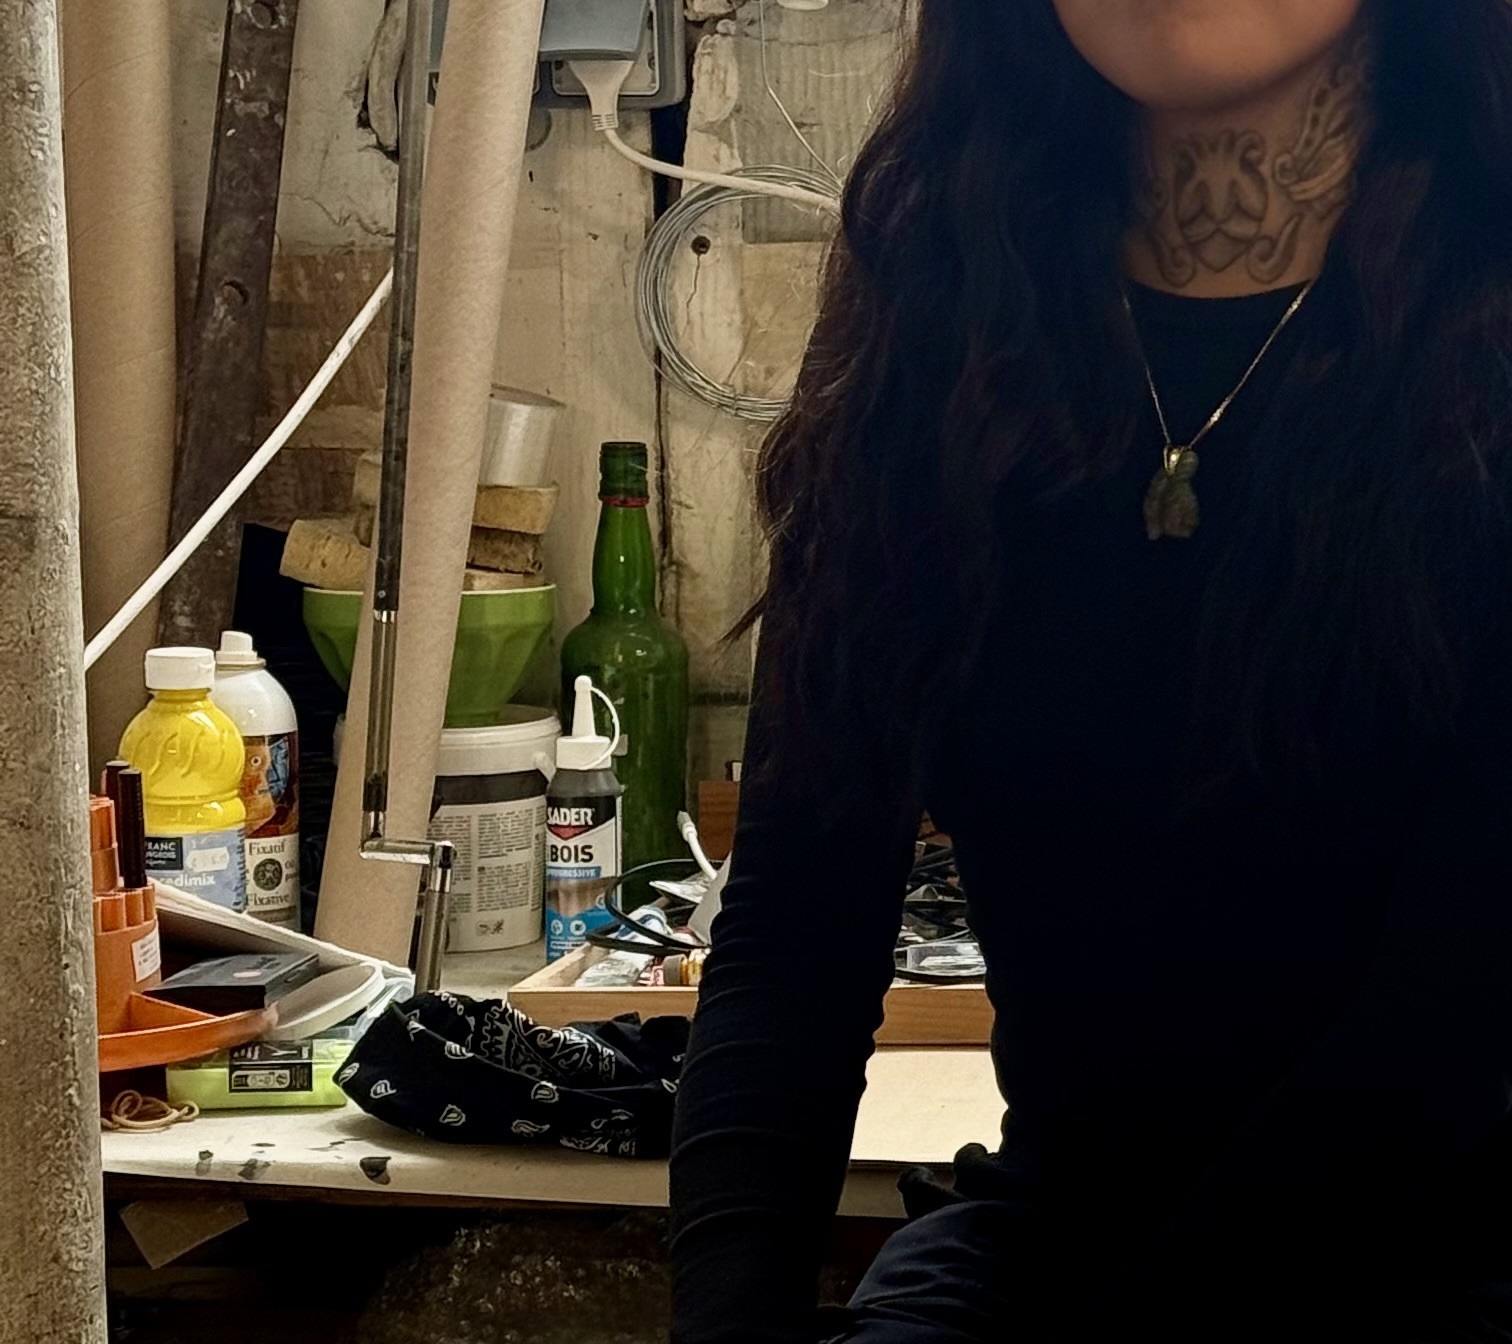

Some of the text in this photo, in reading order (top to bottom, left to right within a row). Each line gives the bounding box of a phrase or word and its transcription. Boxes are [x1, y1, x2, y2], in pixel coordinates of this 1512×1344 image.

[547, 807, 594, 826] SADER
[249, 838, 286, 856] Fixatif
[550, 844, 594, 863] BOIS
